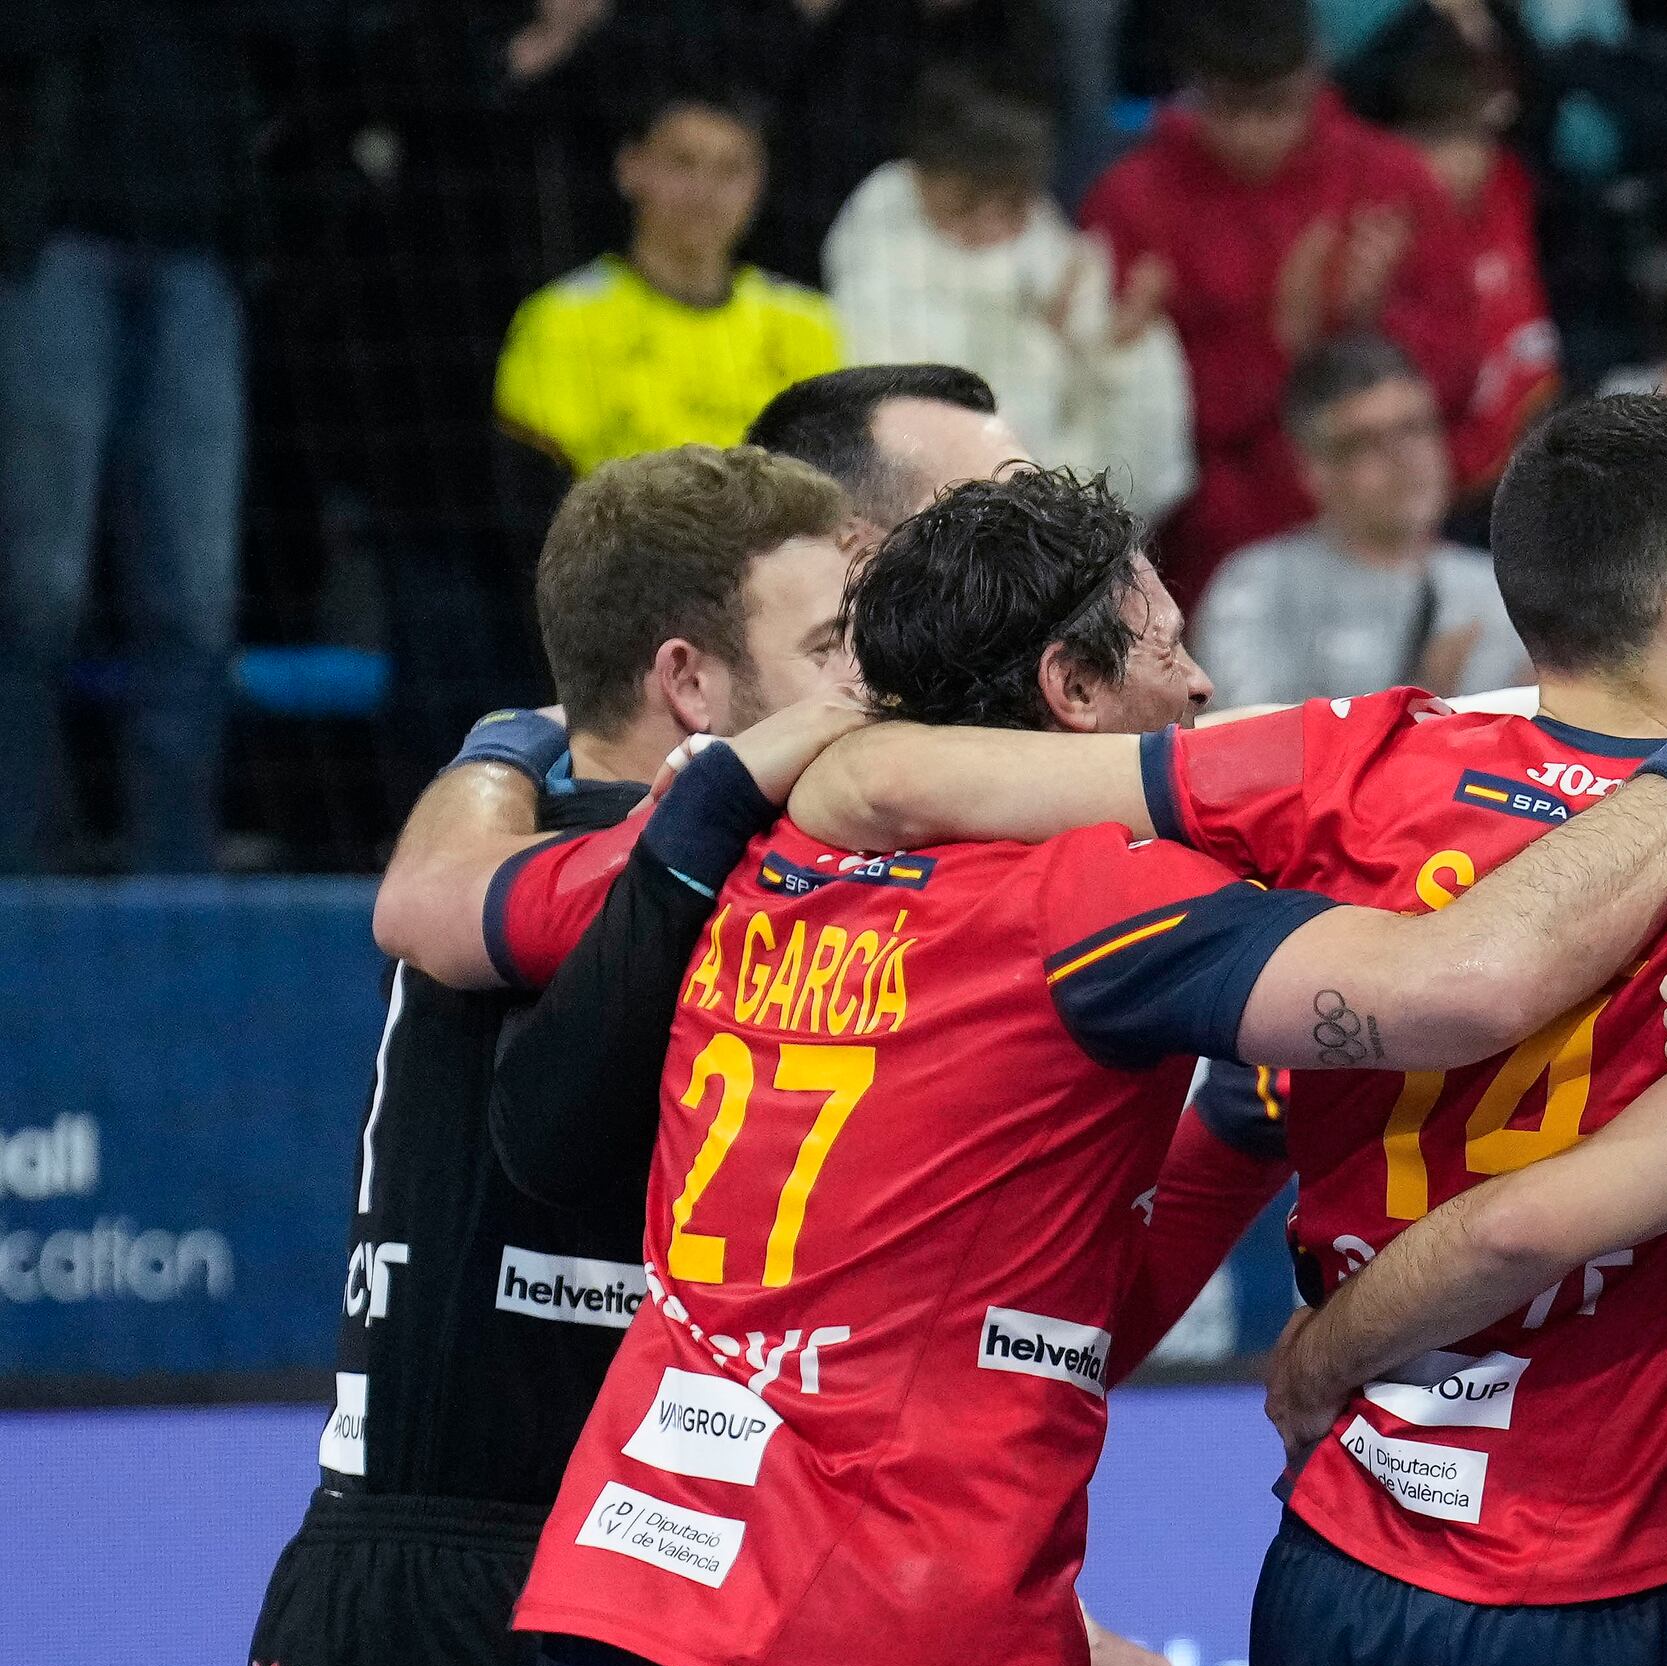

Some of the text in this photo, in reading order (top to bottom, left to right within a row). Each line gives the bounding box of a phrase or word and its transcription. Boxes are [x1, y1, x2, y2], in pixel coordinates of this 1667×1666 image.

[683, 903, 917, 1036] A. GARCÍA
[0, 1112, 98, 1199] all
[667, 1032, 877, 1288] 27
[1375, 1447, 1458, 1480] Diputació
[1398, 1480, 1471, 1508] València
[645, 1512, 721, 1548] Diputació
[632, 1533, 720, 1574] de València
